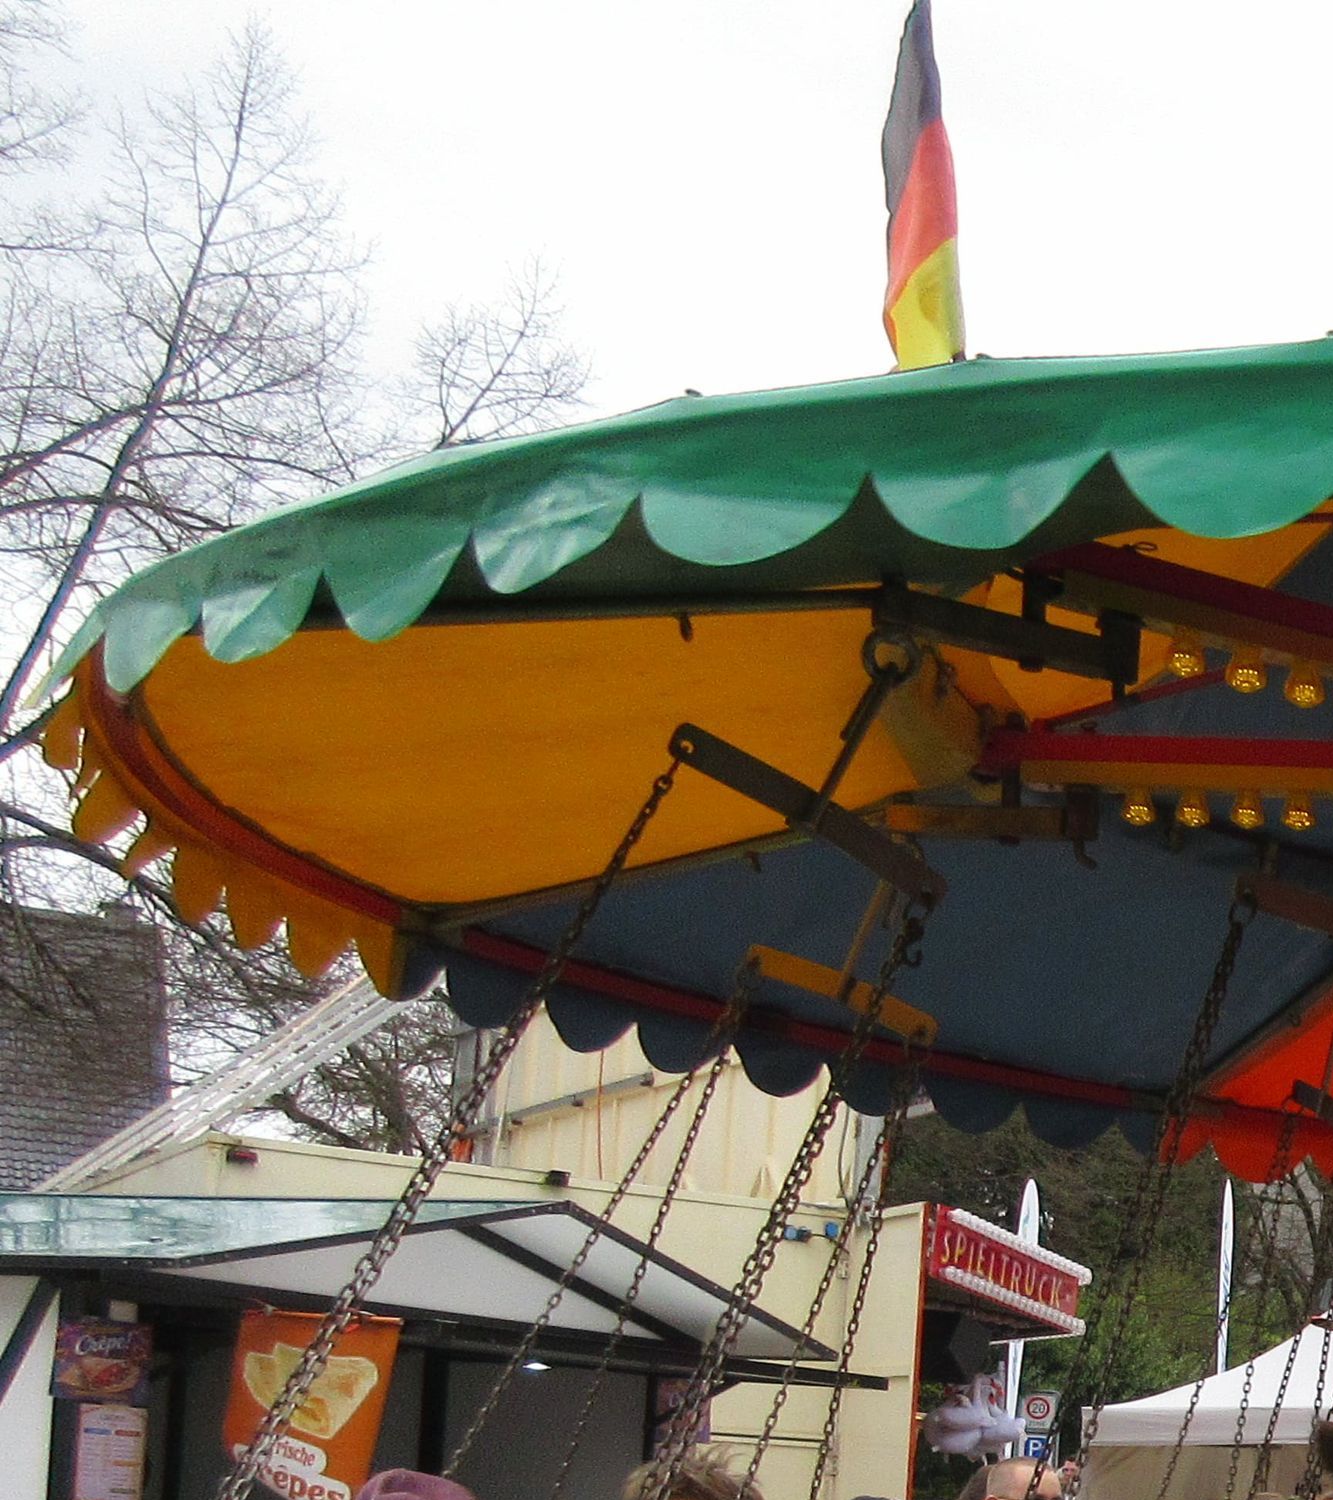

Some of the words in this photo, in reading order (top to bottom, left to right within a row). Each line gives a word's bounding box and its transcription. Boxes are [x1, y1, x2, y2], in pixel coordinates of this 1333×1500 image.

[941, 1229, 1064, 1308] SPIELTRUCK
[1031, 1402, 1046, 1414] 20
[272, 1439, 317, 1467] rische
[1029, 1440, 1042, 1457] P
